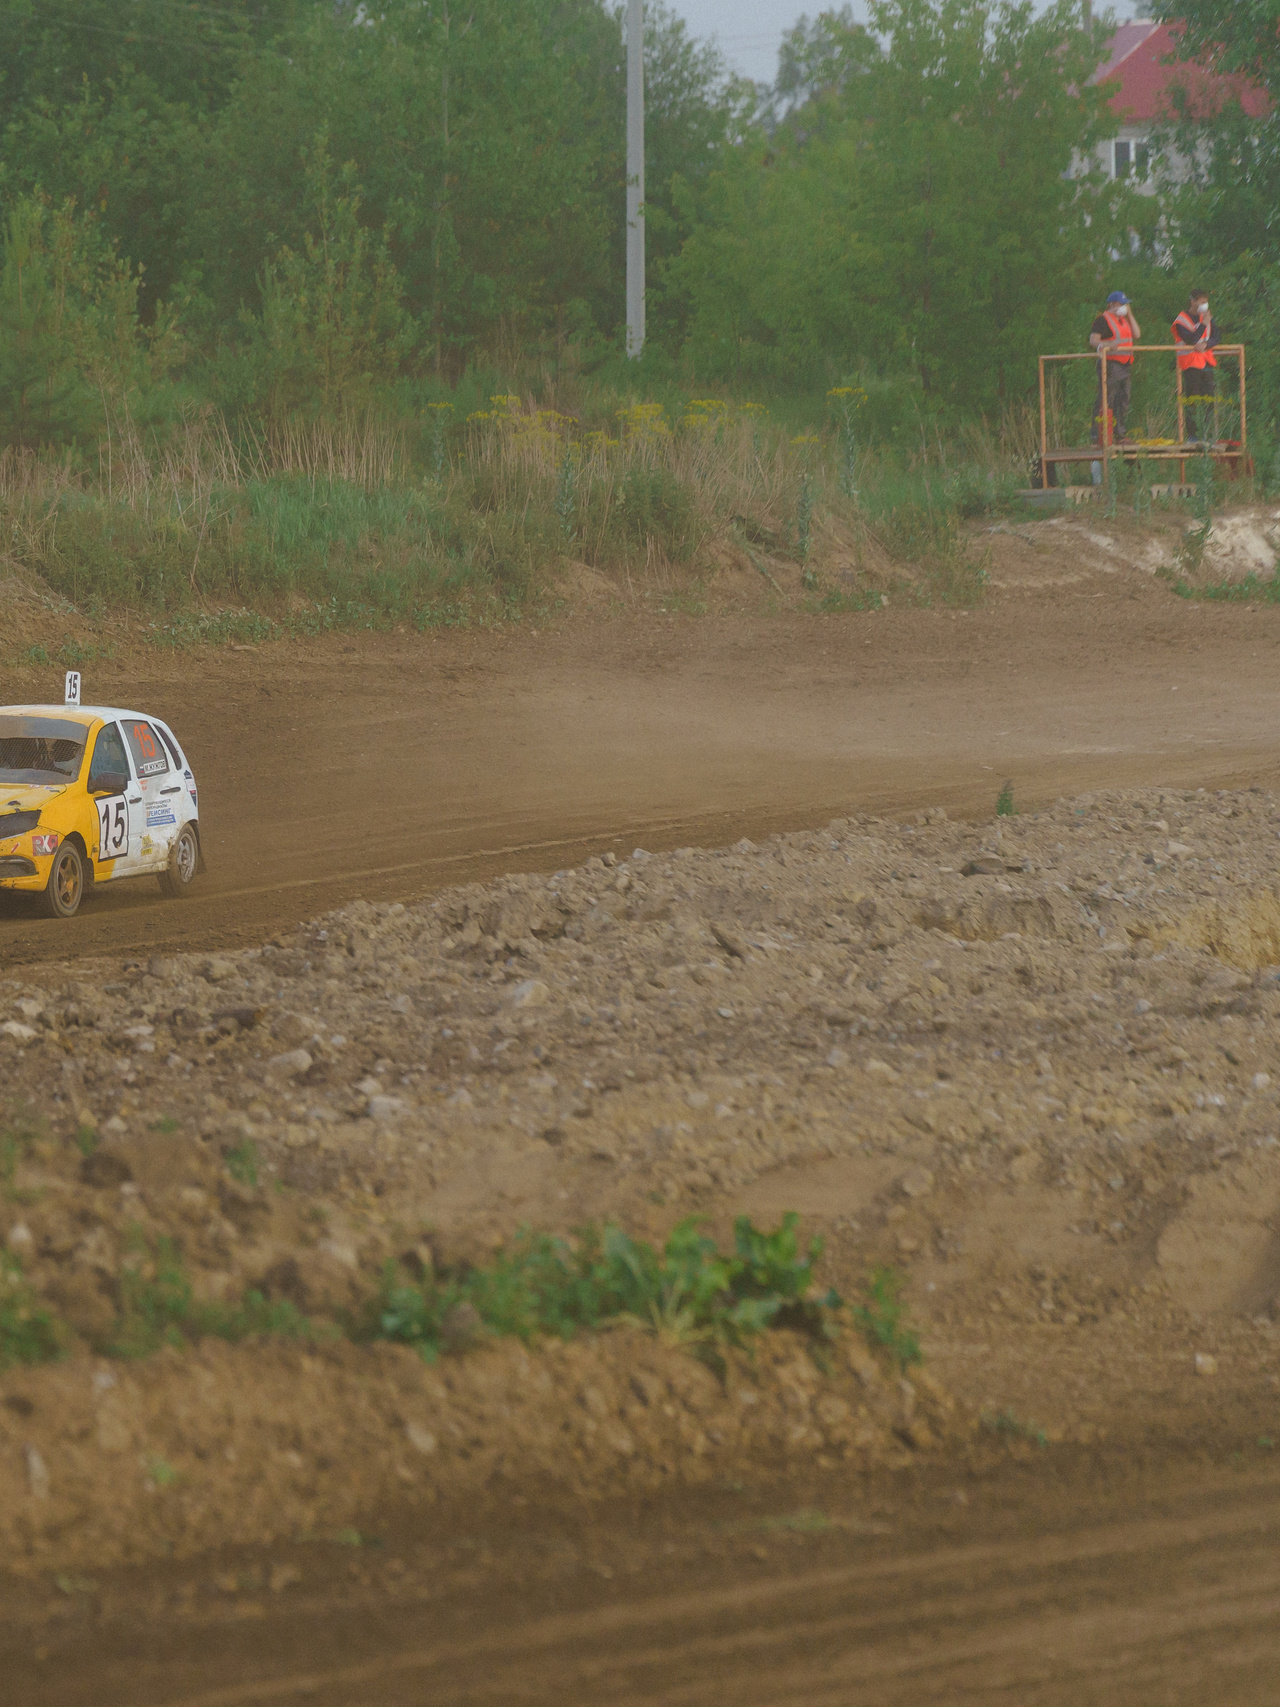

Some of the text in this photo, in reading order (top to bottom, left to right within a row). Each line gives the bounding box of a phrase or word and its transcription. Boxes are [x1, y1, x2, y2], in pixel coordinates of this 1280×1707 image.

[68, 674, 78, 699] 15
[133, 724, 156, 758] 15
[102, 801, 125, 850] 15
